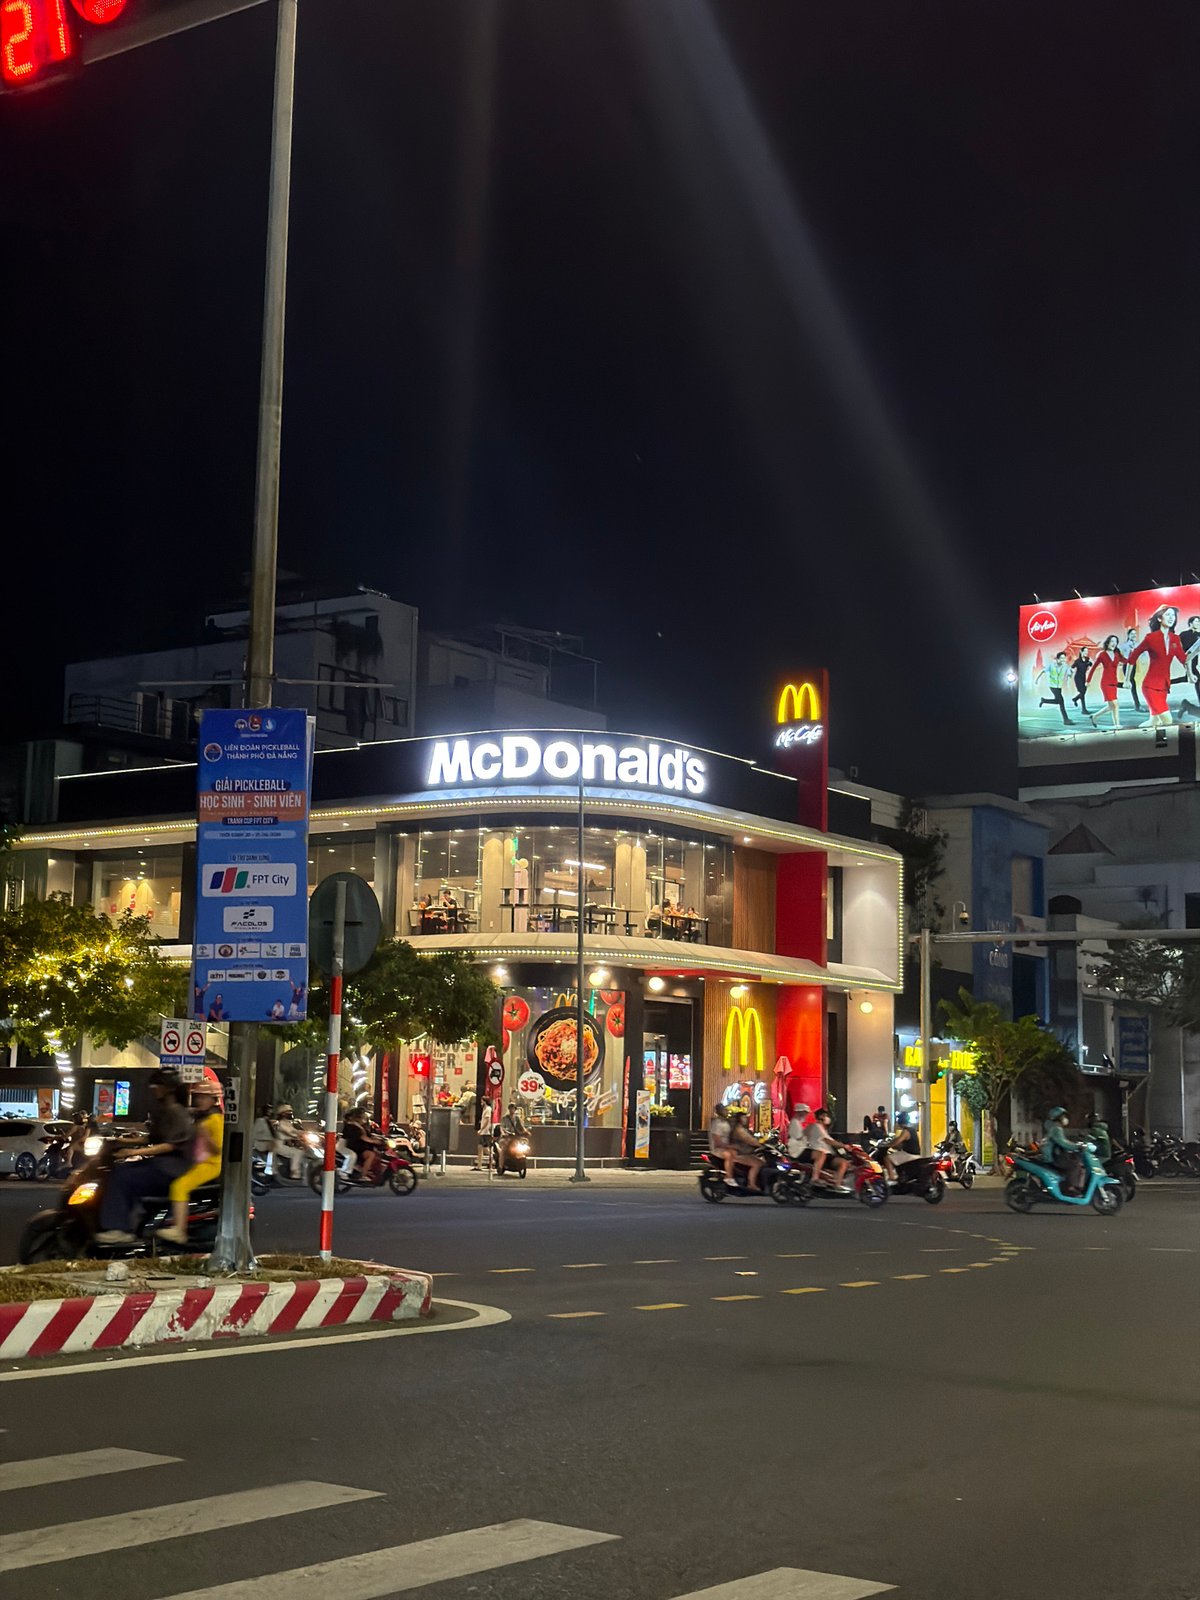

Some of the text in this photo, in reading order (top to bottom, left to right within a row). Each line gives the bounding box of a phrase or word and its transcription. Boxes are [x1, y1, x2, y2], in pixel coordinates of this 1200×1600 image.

[5, 0, 66, 77] 21
[262, 743, 300, 751] PICKLEBALL
[427, 736, 705, 794] McDonald's
[215, 776, 287, 791] GIẢI PICKLEBALL
[200, 795, 219, 811] HỌC
[221, 795, 245, 809] SINH
[253, 794, 277, 808] SINH
[279, 792, 302, 808] VIÊN
[252, 874, 290, 886] FPT City
